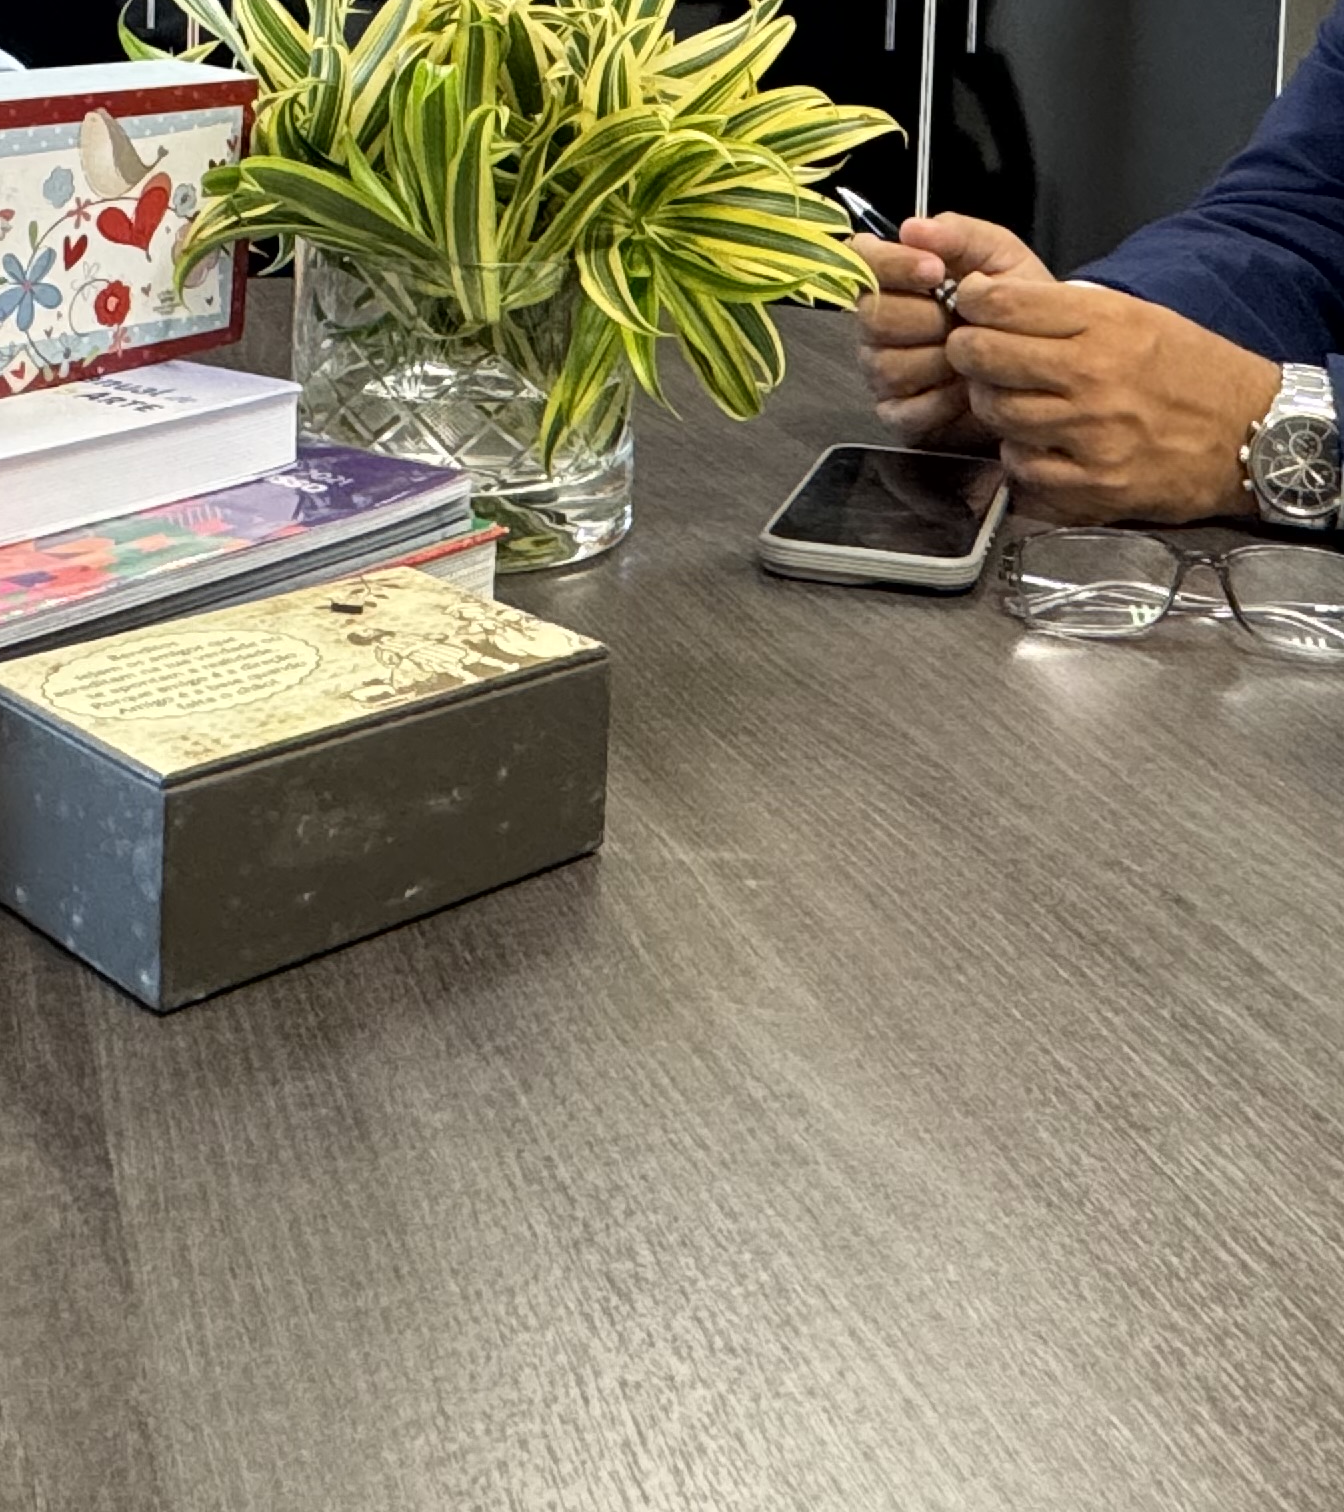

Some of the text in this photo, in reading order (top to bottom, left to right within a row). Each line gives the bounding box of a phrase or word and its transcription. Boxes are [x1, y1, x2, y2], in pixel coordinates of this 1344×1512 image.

[148, 645, 204, 664] amigos
[208, 636, 236, 649] que
[196, 641, 257, 662] verdade
[90, 690, 152, 710] Porque
[157, 675, 209, 695] amigo
[119, 696, 174, 715] Amigo
[207, 677, 243, 690] base
[246, 660, 307, 681] quando
[176, 696, 216, 712] falta
